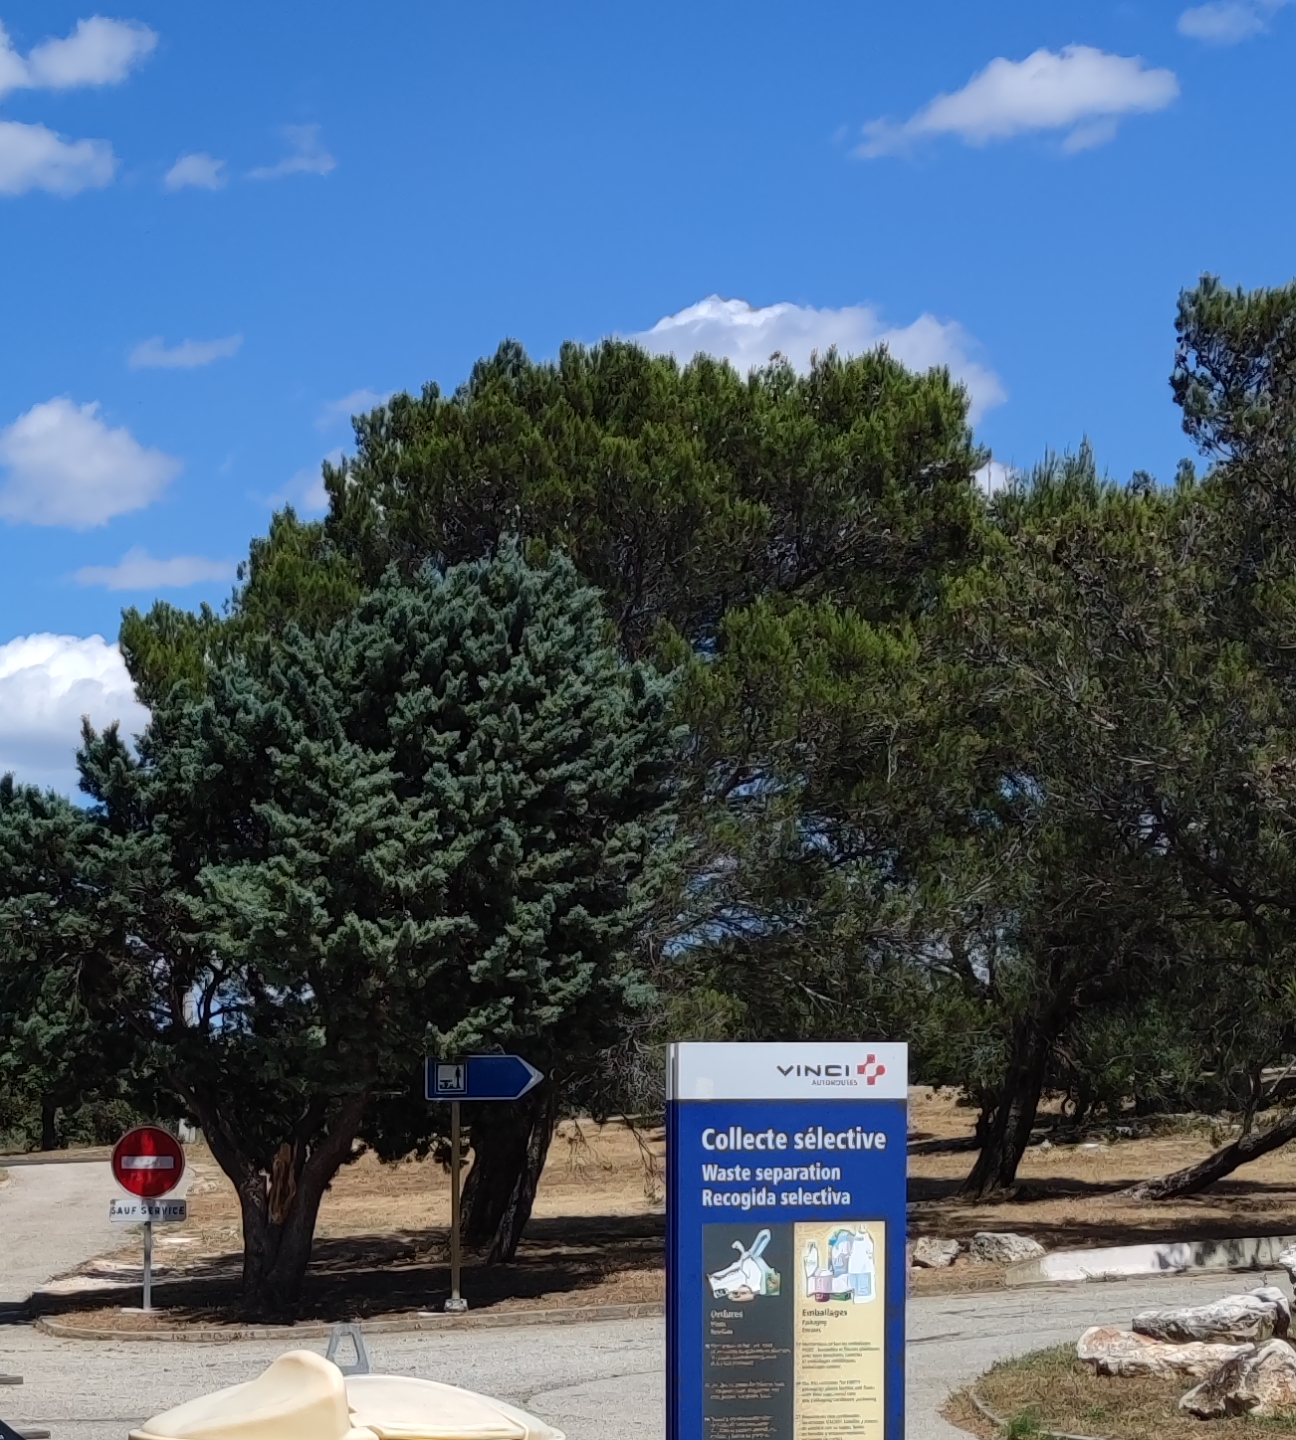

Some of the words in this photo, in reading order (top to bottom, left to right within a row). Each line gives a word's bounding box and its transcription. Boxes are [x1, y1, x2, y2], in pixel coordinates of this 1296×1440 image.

[776, 1064, 850, 1077] VINCI
[811, 1078, 858, 1086] AUTOROUTES
[701, 1126, 788, 1151] Collecte
[793, 1125, 887, 1150] sélective
[701, 1164, 752, 1181] Waste
[755, 1162, 841, 1185] separation
[701, 1187, 776, 1211] Recogida
[780, 1186, 851, 1206] selectiva
[110, 1205, 137, 1216] SAUF
[140, 1205, 185, 1216] SERVICE
